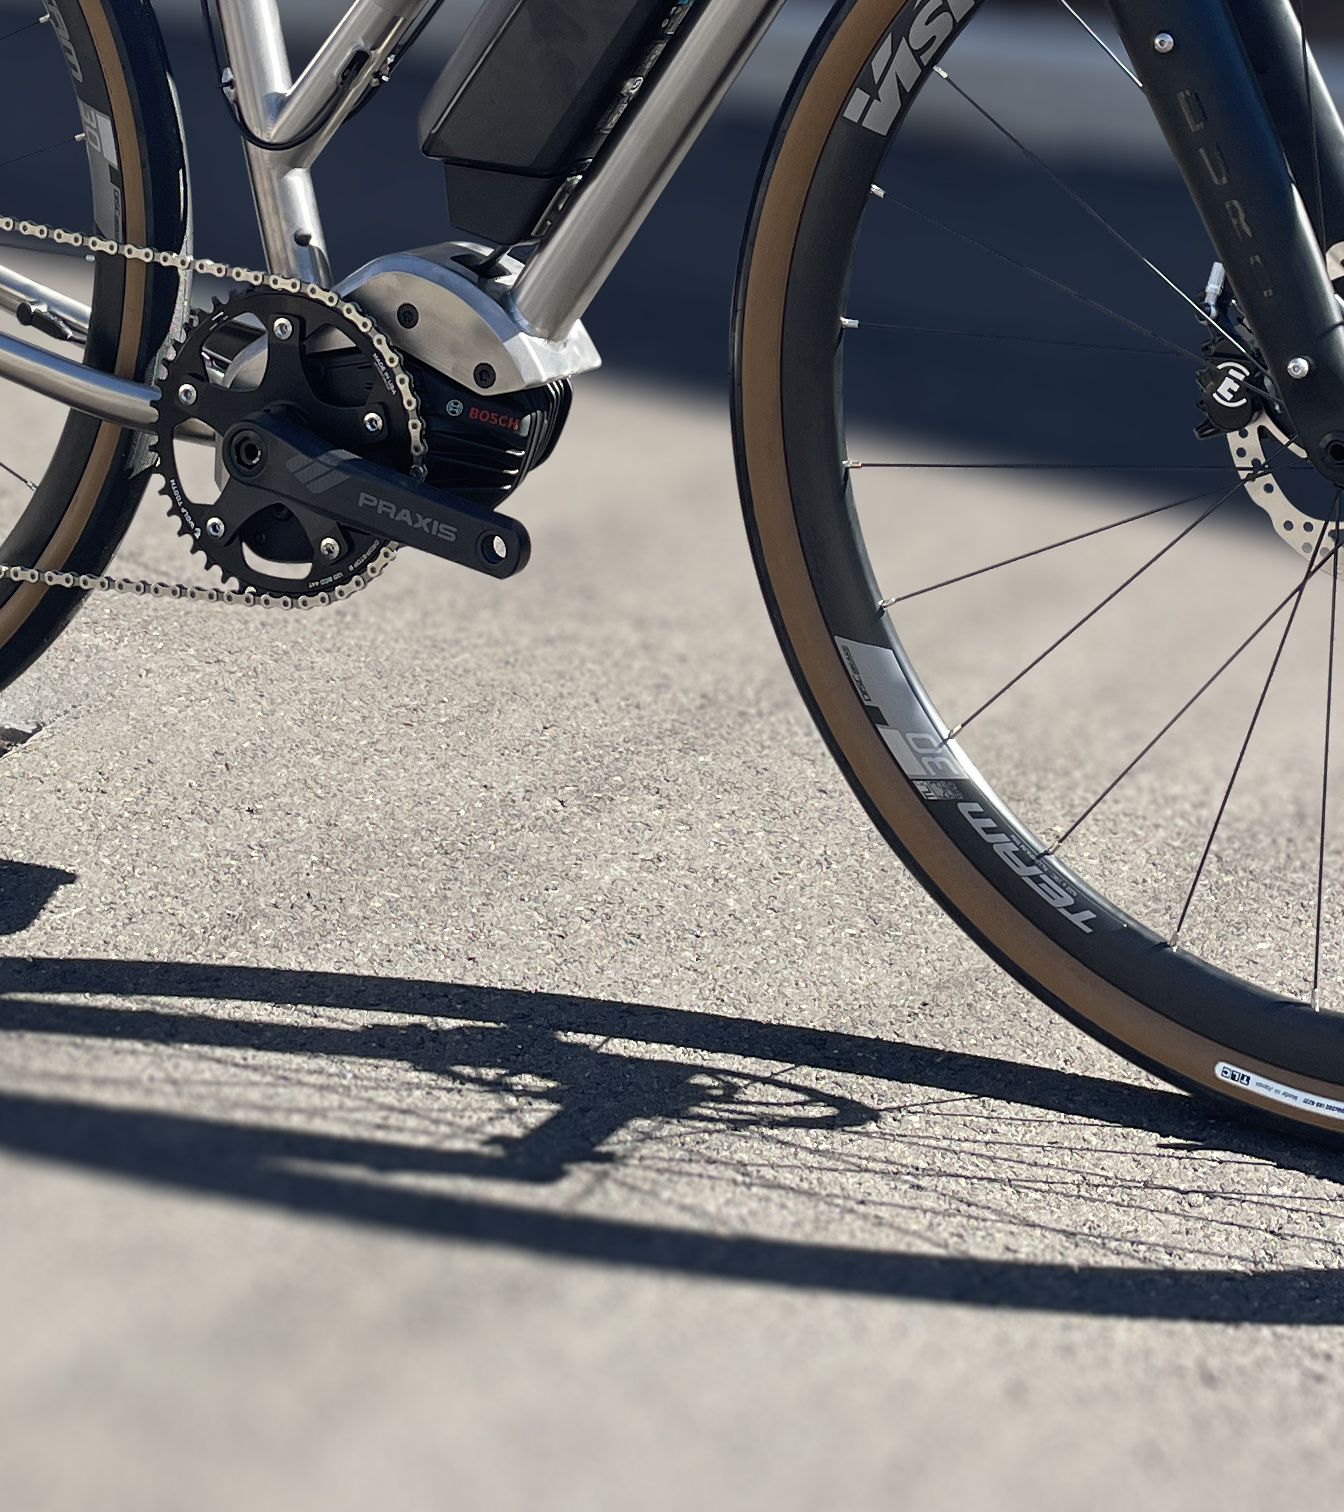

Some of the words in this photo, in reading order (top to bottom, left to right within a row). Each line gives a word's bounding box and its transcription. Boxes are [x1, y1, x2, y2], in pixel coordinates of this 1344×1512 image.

[83, 107, 102, 152] 30
[468, 407, 520, 431] BOSCH
[357, 492, 458, 542] PRAXIS
[906, 732, 961, 776] 30
[956, 801, 1096, 933] TEAM
